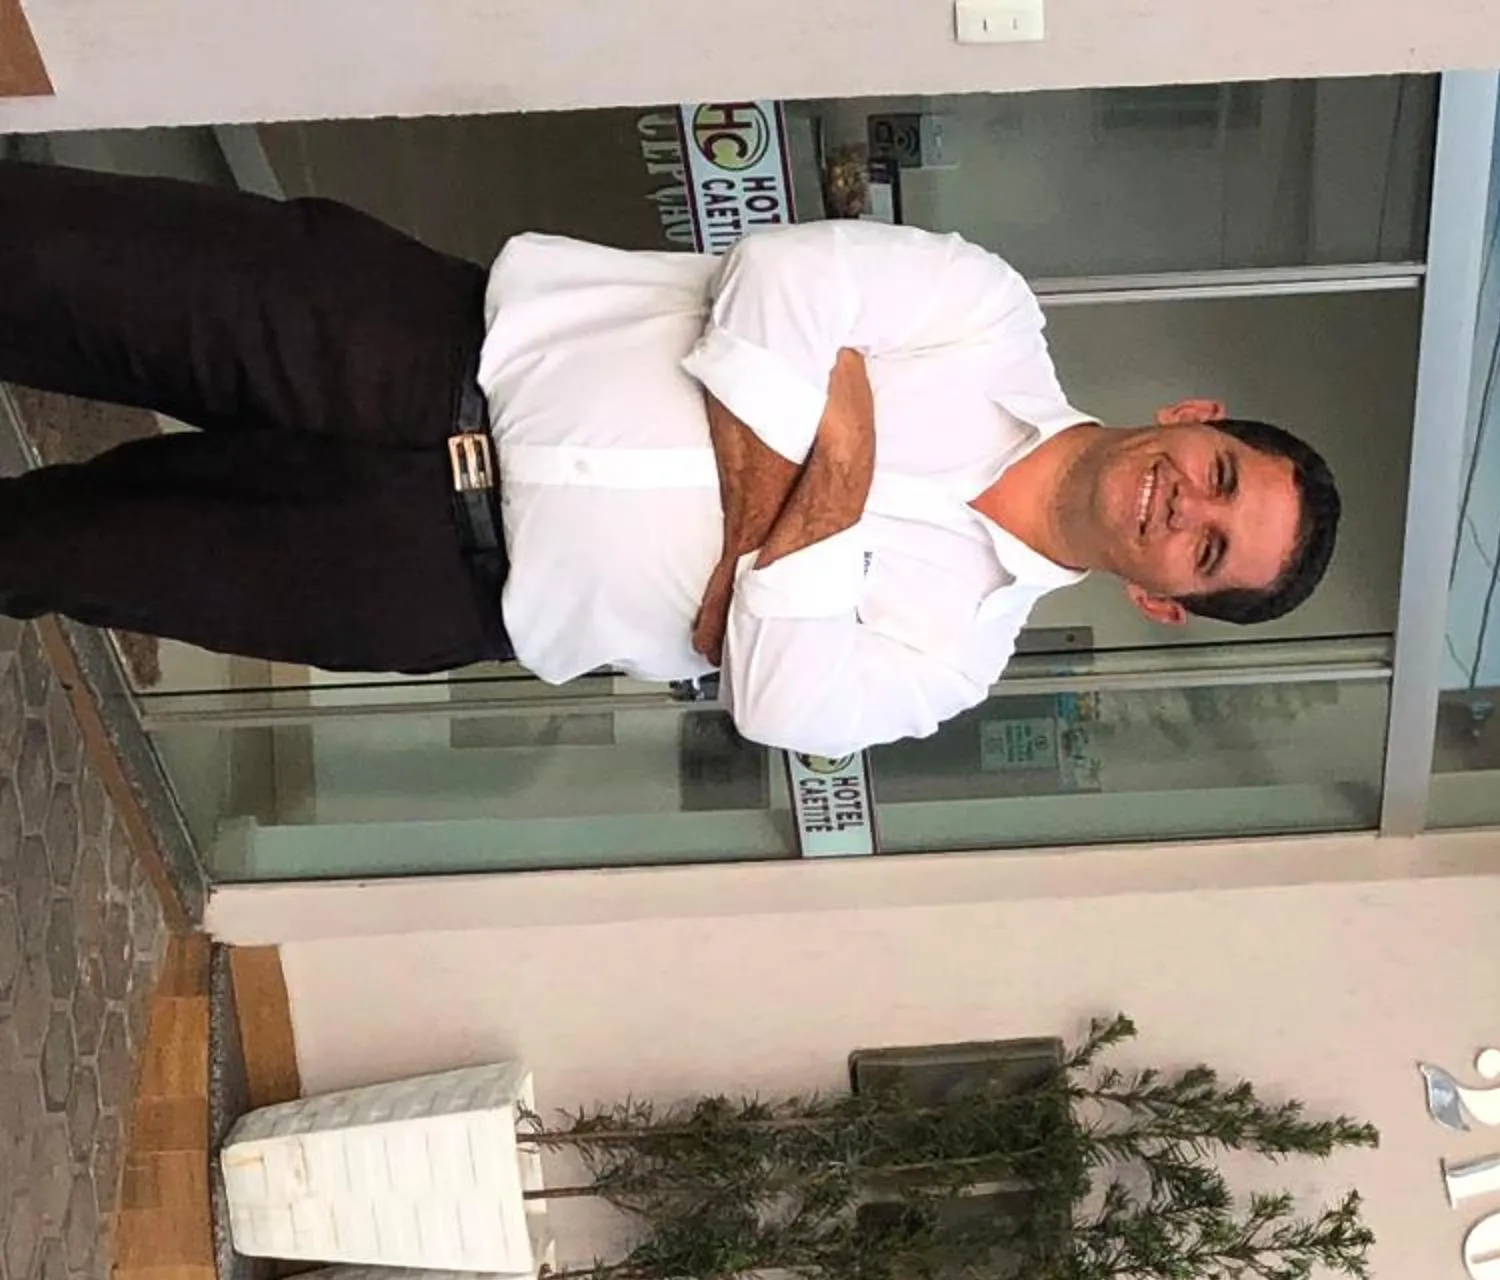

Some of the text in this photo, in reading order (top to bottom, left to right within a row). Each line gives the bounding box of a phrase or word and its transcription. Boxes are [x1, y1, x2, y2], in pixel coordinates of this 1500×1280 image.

[701, 178, 743, 256] CAETIT
[742, 176, 781, 224] HOT
[831, 776, 864, 832] HOTEL
